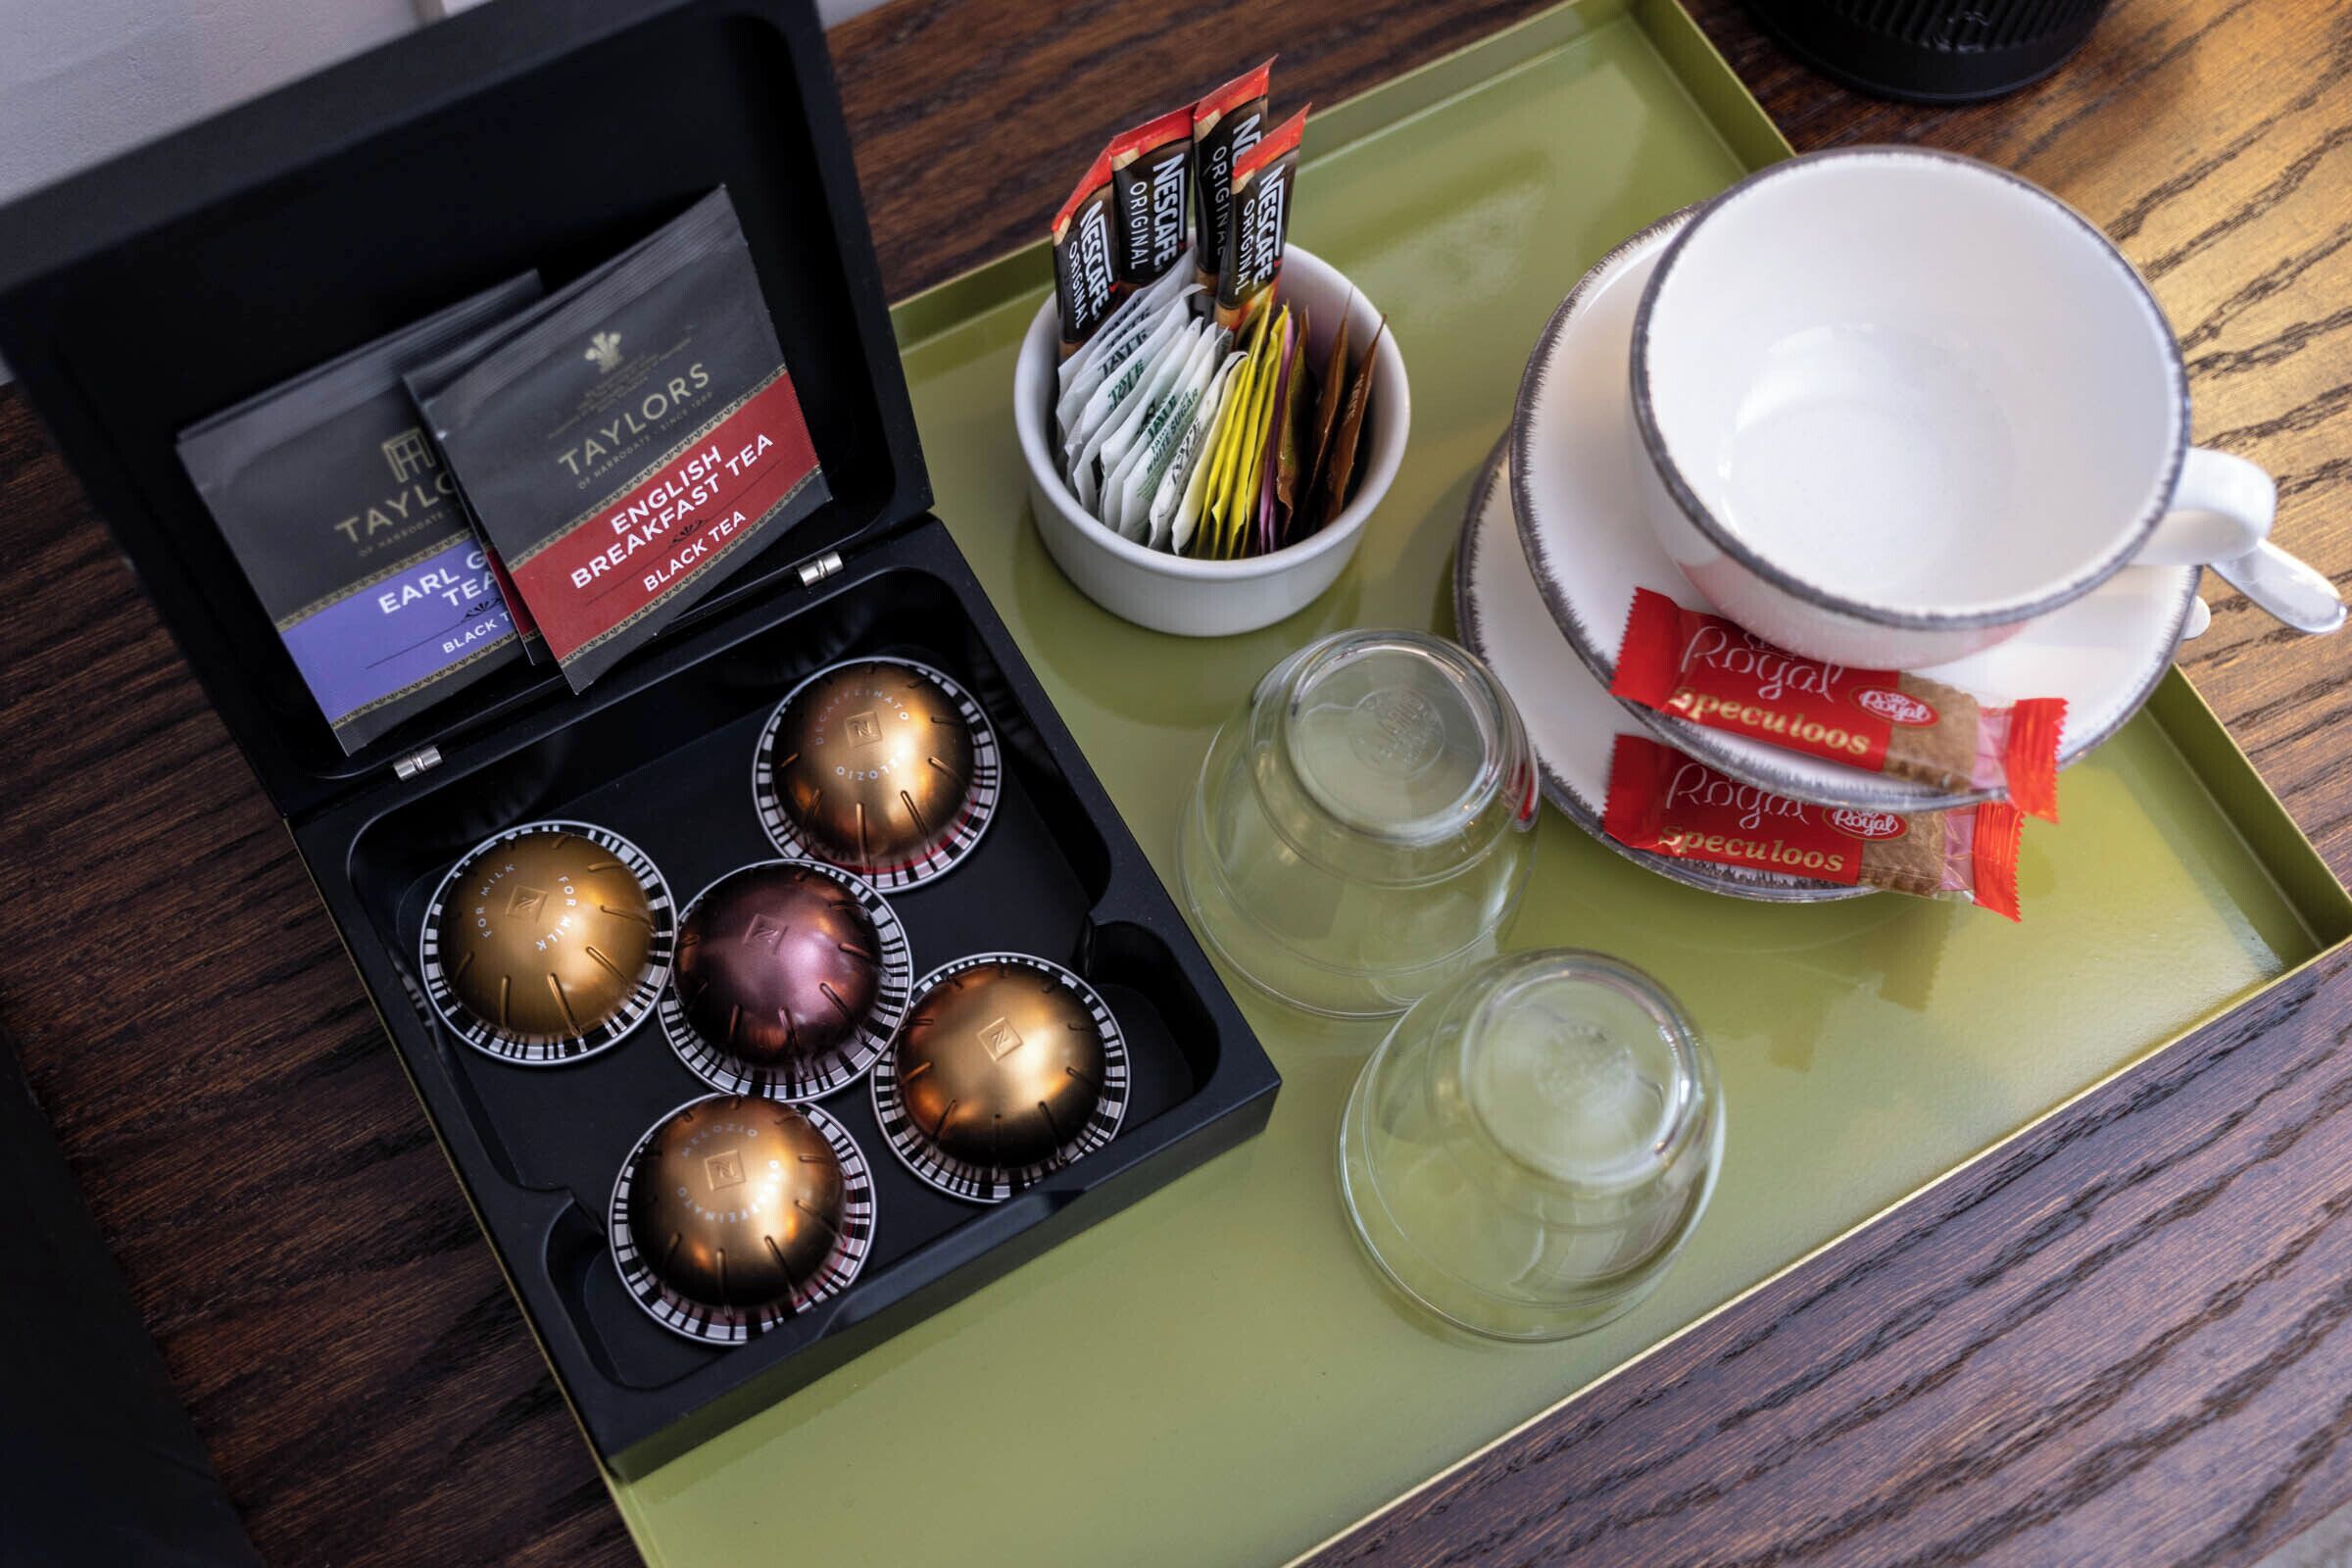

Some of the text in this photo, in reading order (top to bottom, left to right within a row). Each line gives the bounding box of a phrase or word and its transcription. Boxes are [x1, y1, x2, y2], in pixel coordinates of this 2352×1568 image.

[1130, 182, 1150, 270] ORIGINAL
[1235, 199, 1254, 295] ORIGINAL
[1069, 241, 1088, 328] ORIGINAL
[558, 363, 710, 475] TAYLORS
[593, 434, 651, 477] HARROGATE
[1147, 432, 1171, 473] WHITE
[1170, 388, 1198, 434] SUGAR
[334, 471, 456, 543] TAYLO
[570, 434, 774, 588] BREAKFAST TEA
[611, 446, 721, 534] ENGLISH
[643, 511, 747, 591] BLACK TEA
[377, 567, 461, 614] EARL
[443, 618, 498, 654] BLACK
[1681, 625, 1843, 704] Royal
[1668, 687, 1872, 756] Speculoos
[1859, 689, 1931, 722] Royal
[1657, 824, 1845, 872] Speculoos
[1832, 809, 1899, 837] Royal
[475, 863, 515, 939] FOR MILK
[536, 875, 576, 952] FOR MILK
